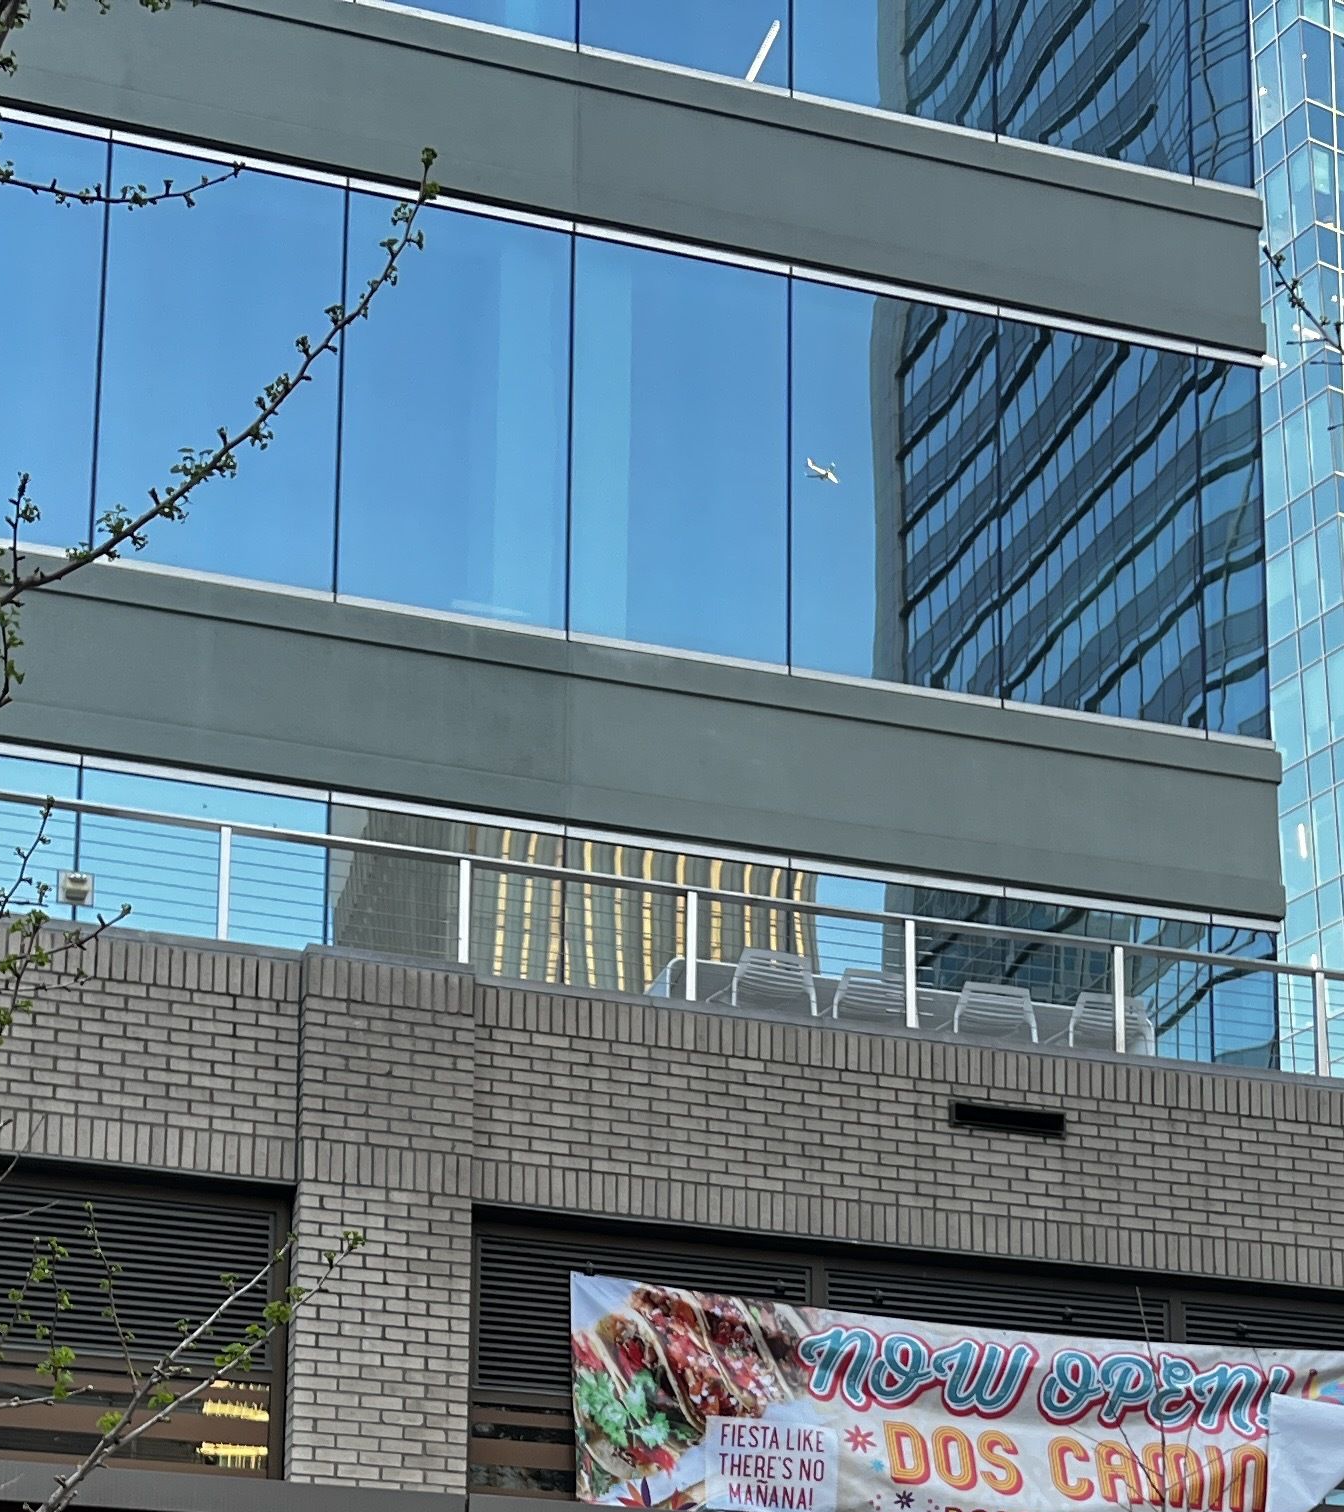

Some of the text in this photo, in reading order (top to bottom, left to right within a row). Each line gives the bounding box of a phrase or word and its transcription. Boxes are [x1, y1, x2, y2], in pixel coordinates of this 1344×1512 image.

[798, 1324, 1294, 1437] NOW OPEN!
[720, 1423, 825, 1453] FIESTA LIKE
[719, 1453, 825, 1481] THERE'S NO
[883, 1421, 1024, 1495] DOS
[729, 1480, 813, 1511] MAÑANA!
